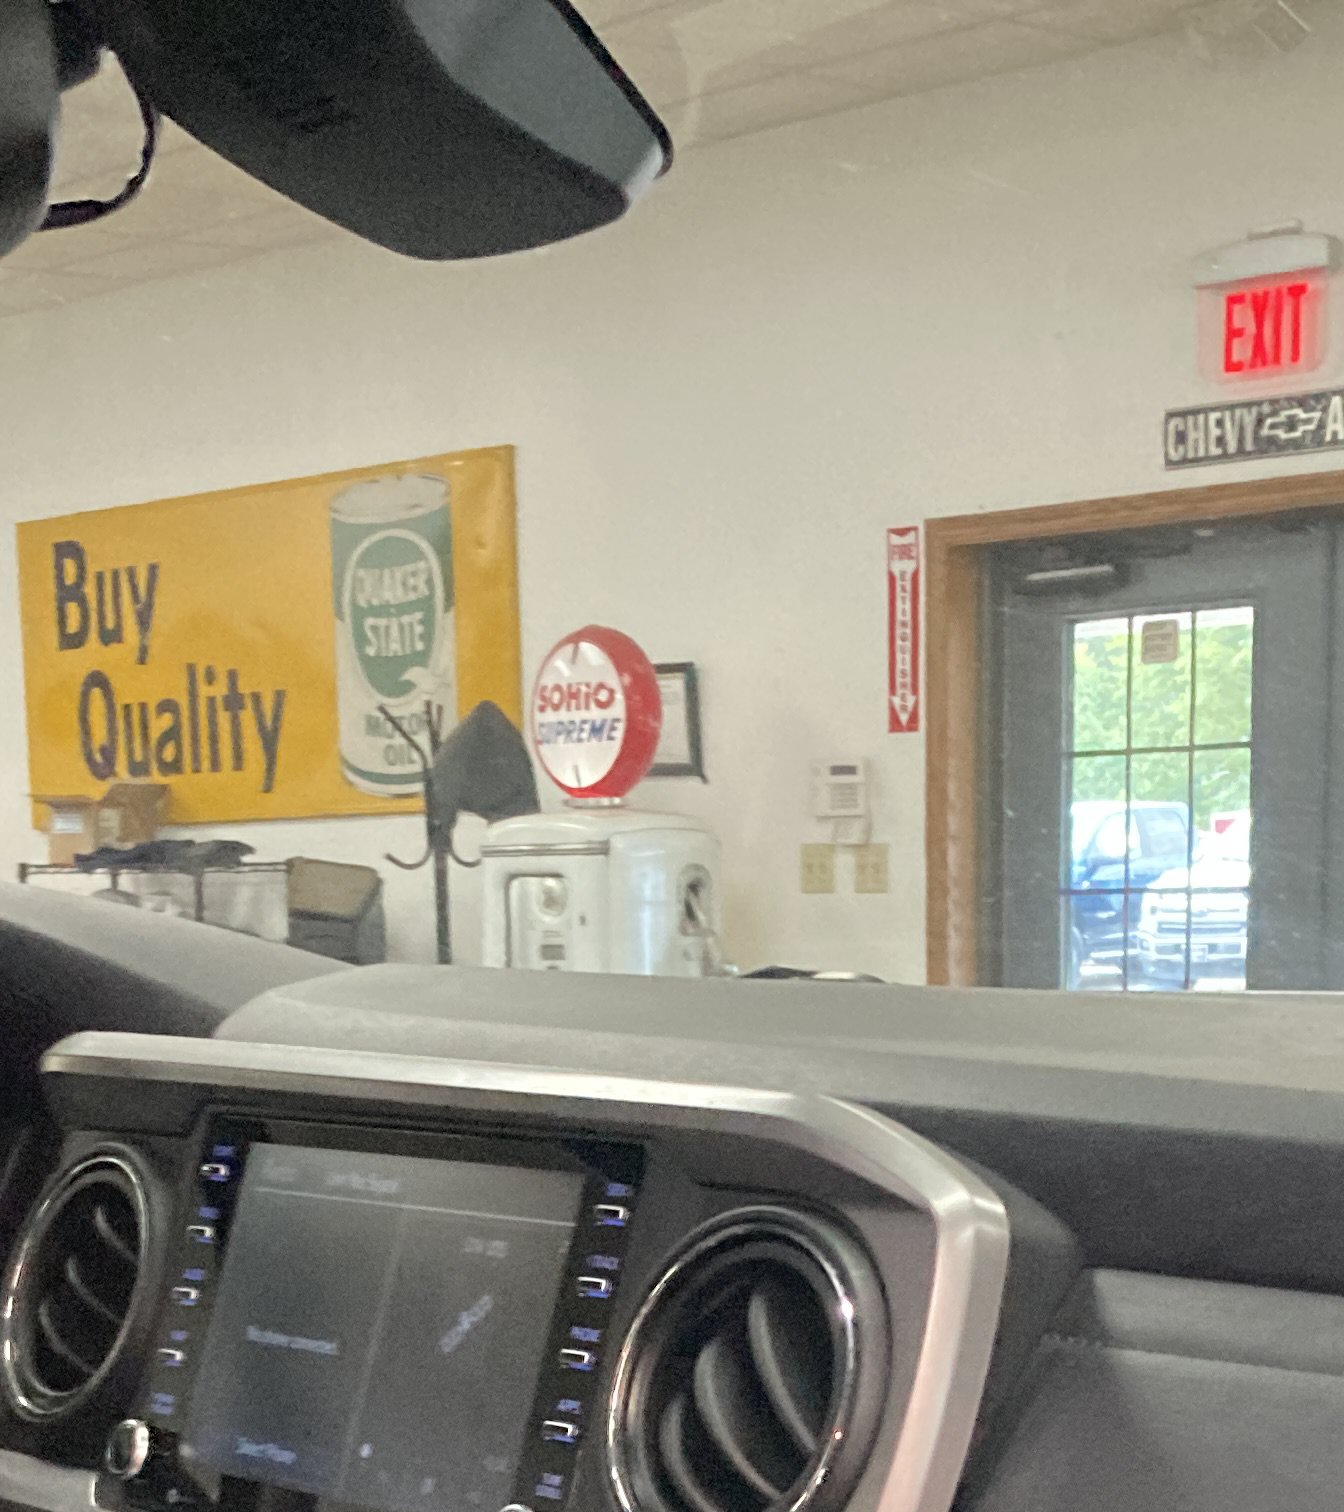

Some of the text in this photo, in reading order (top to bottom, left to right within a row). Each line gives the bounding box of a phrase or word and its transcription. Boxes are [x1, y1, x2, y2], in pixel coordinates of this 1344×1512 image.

[1223, 283, 1308, 373] EXIT
[1167, 409, 1258, 461] CHEVY
[52, 540, 160, 665] Buy
[357, 559, 430, 608] QUAKER
[363, 611, 425, 656] STATE
[78, 663, 286, 792] Quality
[539, 717, 622, 745] SUPREME
